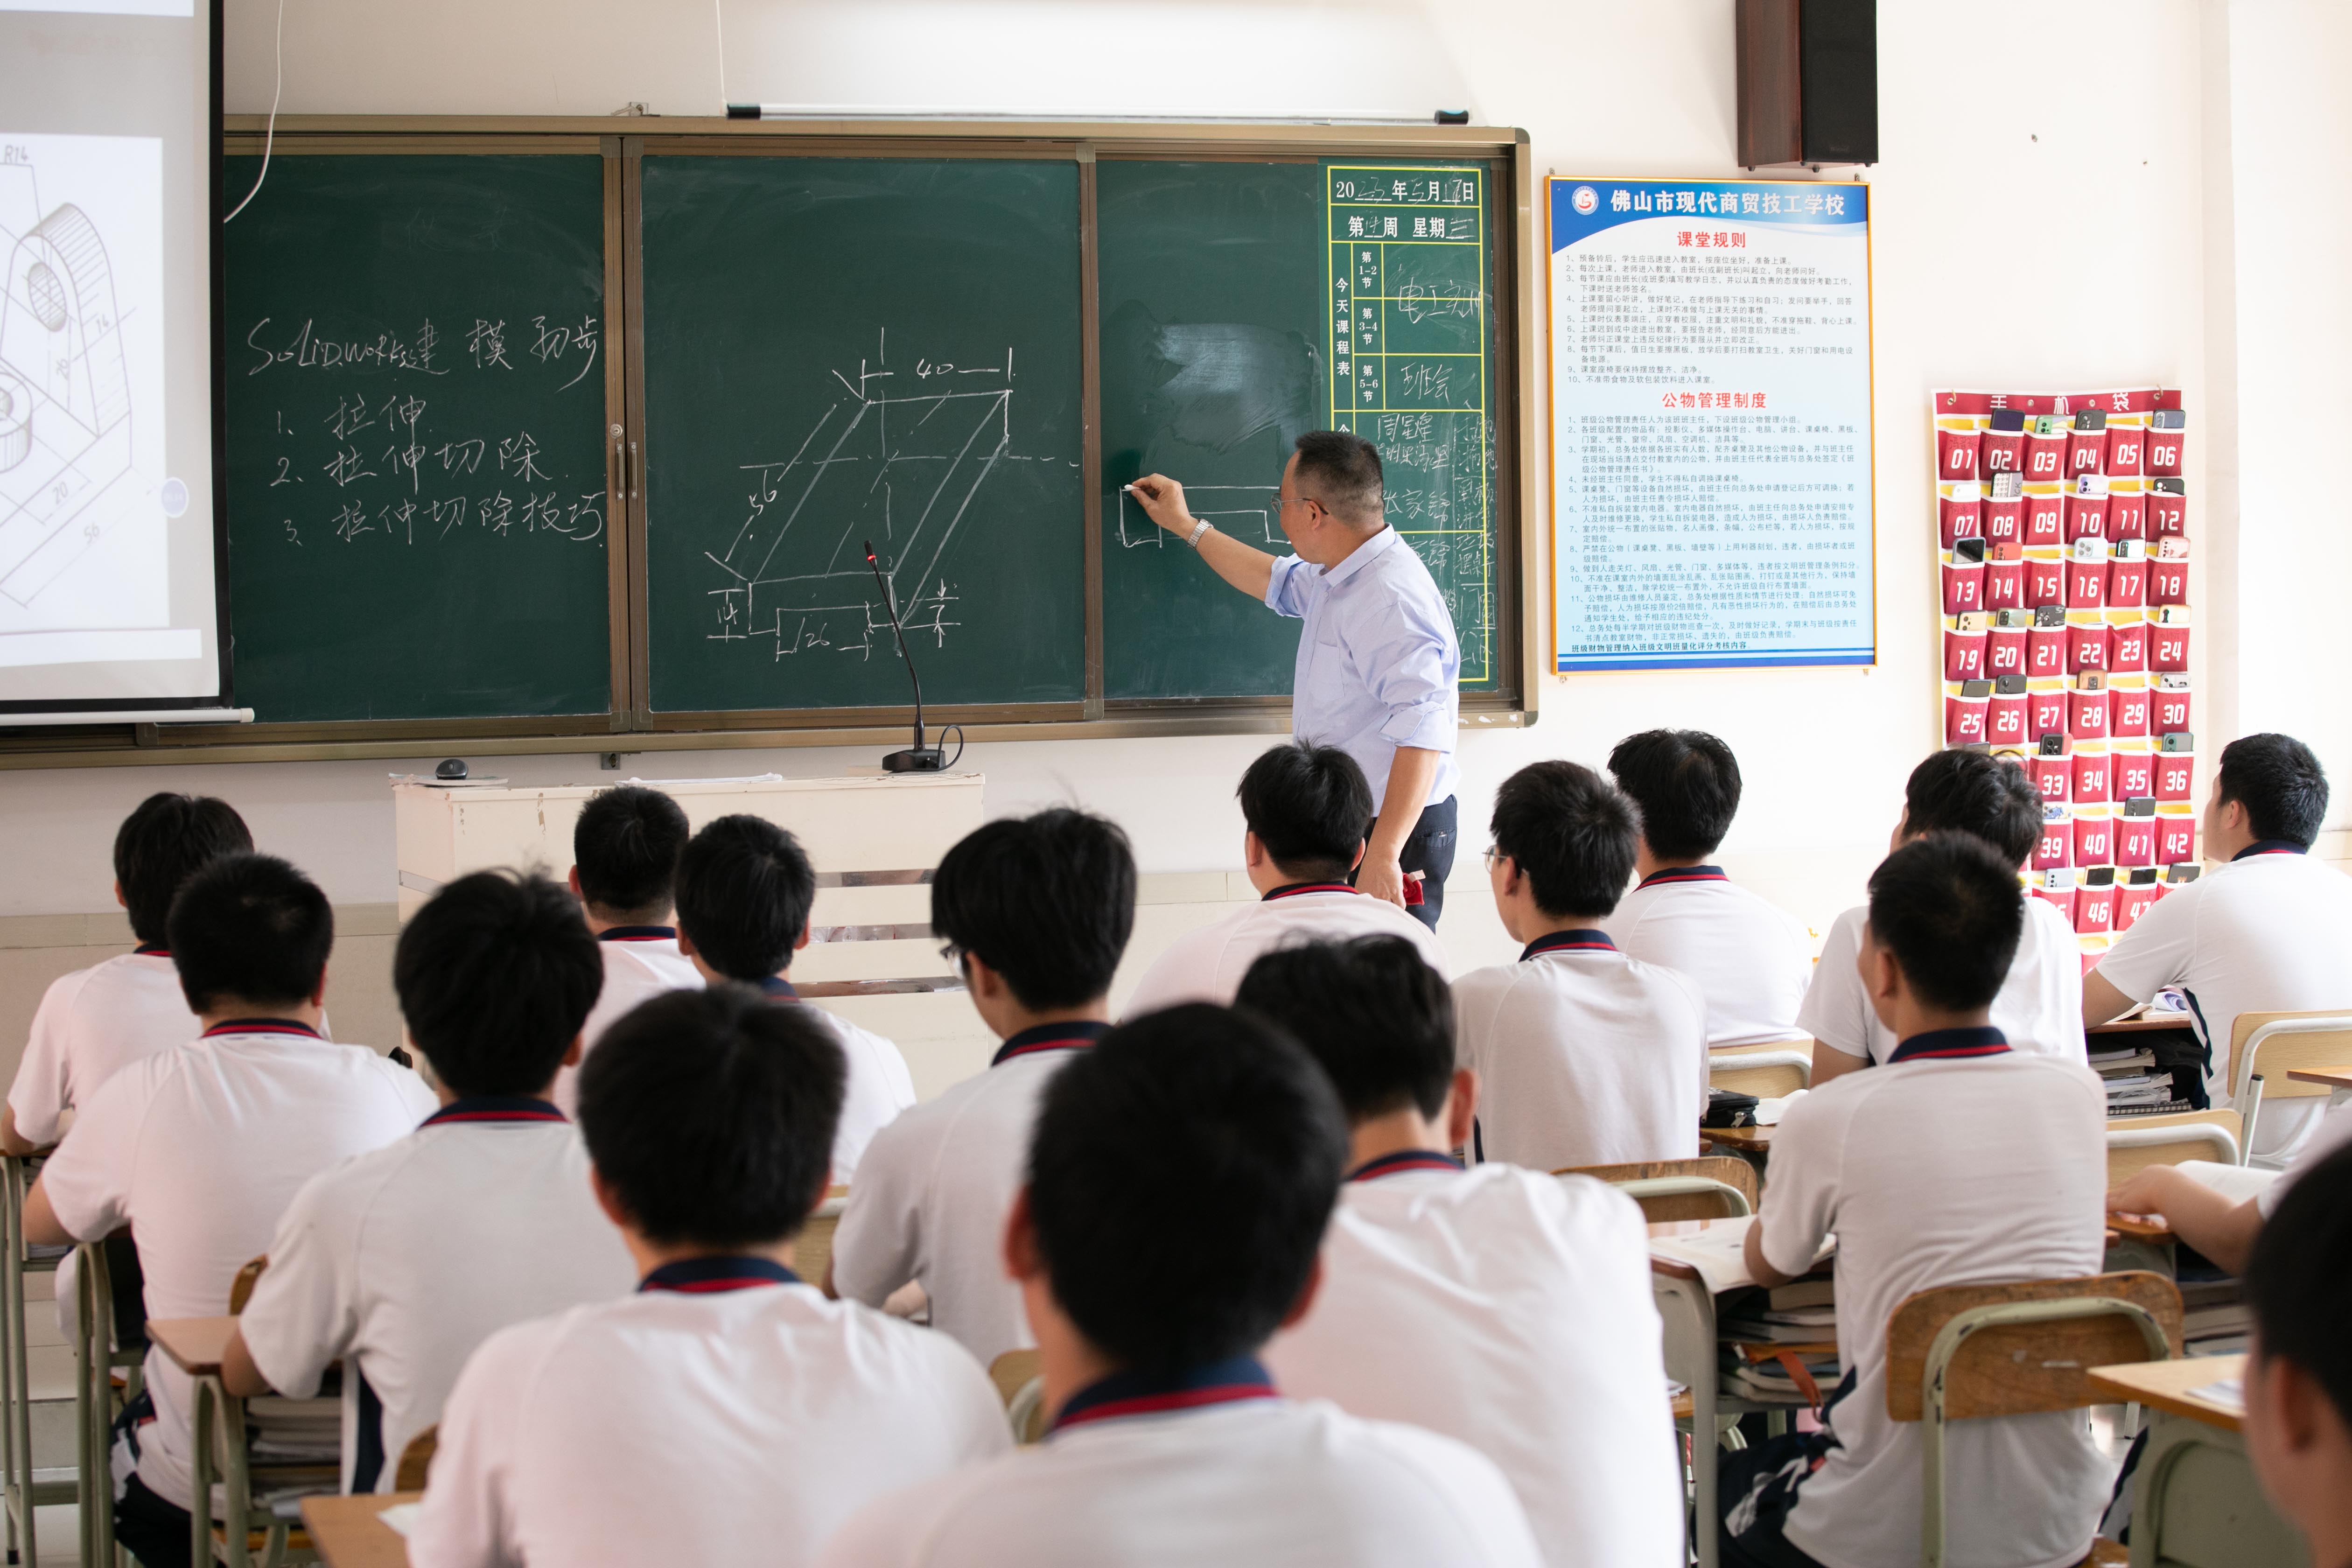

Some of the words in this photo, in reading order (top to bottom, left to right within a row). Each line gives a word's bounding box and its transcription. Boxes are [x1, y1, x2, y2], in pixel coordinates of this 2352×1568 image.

[4, 145, 29, 163] R14
[1610, 189, 1845, 216] 佛山市现代商贸技工学校
[1677, 231, 1746, 249] 课堂规则
[1335, 278, 1350, 376] 今天课程表
[917, 359, 954, 377] 40
[1662, 392, 1767, 410] 公物管理制度
[1951, 448, 1973, 469] 01
[1990, 449, 2013, 470] 02
[2034, 452, 2057, 472] 03
[2075, 448, 2097, 469] 04
[2116, 444, 2138, 465] 05
[2153, 446, 2177, 466] 06
[52, 481, 69, 505] 20
[1954, 515, 1974, 536] 07
[1992, 516, 2014, 536] 08
[2035, 511, 2057, 533] 09
[2080, 512, 2100, 533] 10
[2121, 509, 2139, 531] 11
[2159, 510, 2179, 531] 12
[1957, 581, 1975, 602] 13
[1995, 578, 2014, 599] 14
[2037, 576, 2058, 597] 15
[2079, 576, 2099, 598] 16
[2121, 575, 2139, 596] 17
[2160, 575, 2180, 596] 18
[1959, 650, 1978, 670] 19
[1995, 646, 2017, 667] 20
[2037, 644, 2057, 666] 21
[2079, 643, 2101, 664] 22
[2120, 640, 2141, 661] 23
[2160, 641, 2182, 661] 24
[1960, 713, 1982, 734] 25
[1997, 710, 2020, 732] 26
[2038, 706, 2060, 728] 27
[2081, 706, 2103, 728] 28
[2123, 703, 2145, 725] 29
[2163, 704, 2185, 724] 30
[2042, 774, 2064, 796] 33
[2082, 770, 2103, 792] 34
[2125, 769, 2147, 791] 35
[2165, 770, 2187, 791] 36
[2040, 837, 2063, 859] 39
[2084, 833, 2106, 855] 40
[2128, 834, 2148, 856] 41
[2167, 833, 2188, 854] 42
[2087, 901, 2109, 923] 46
